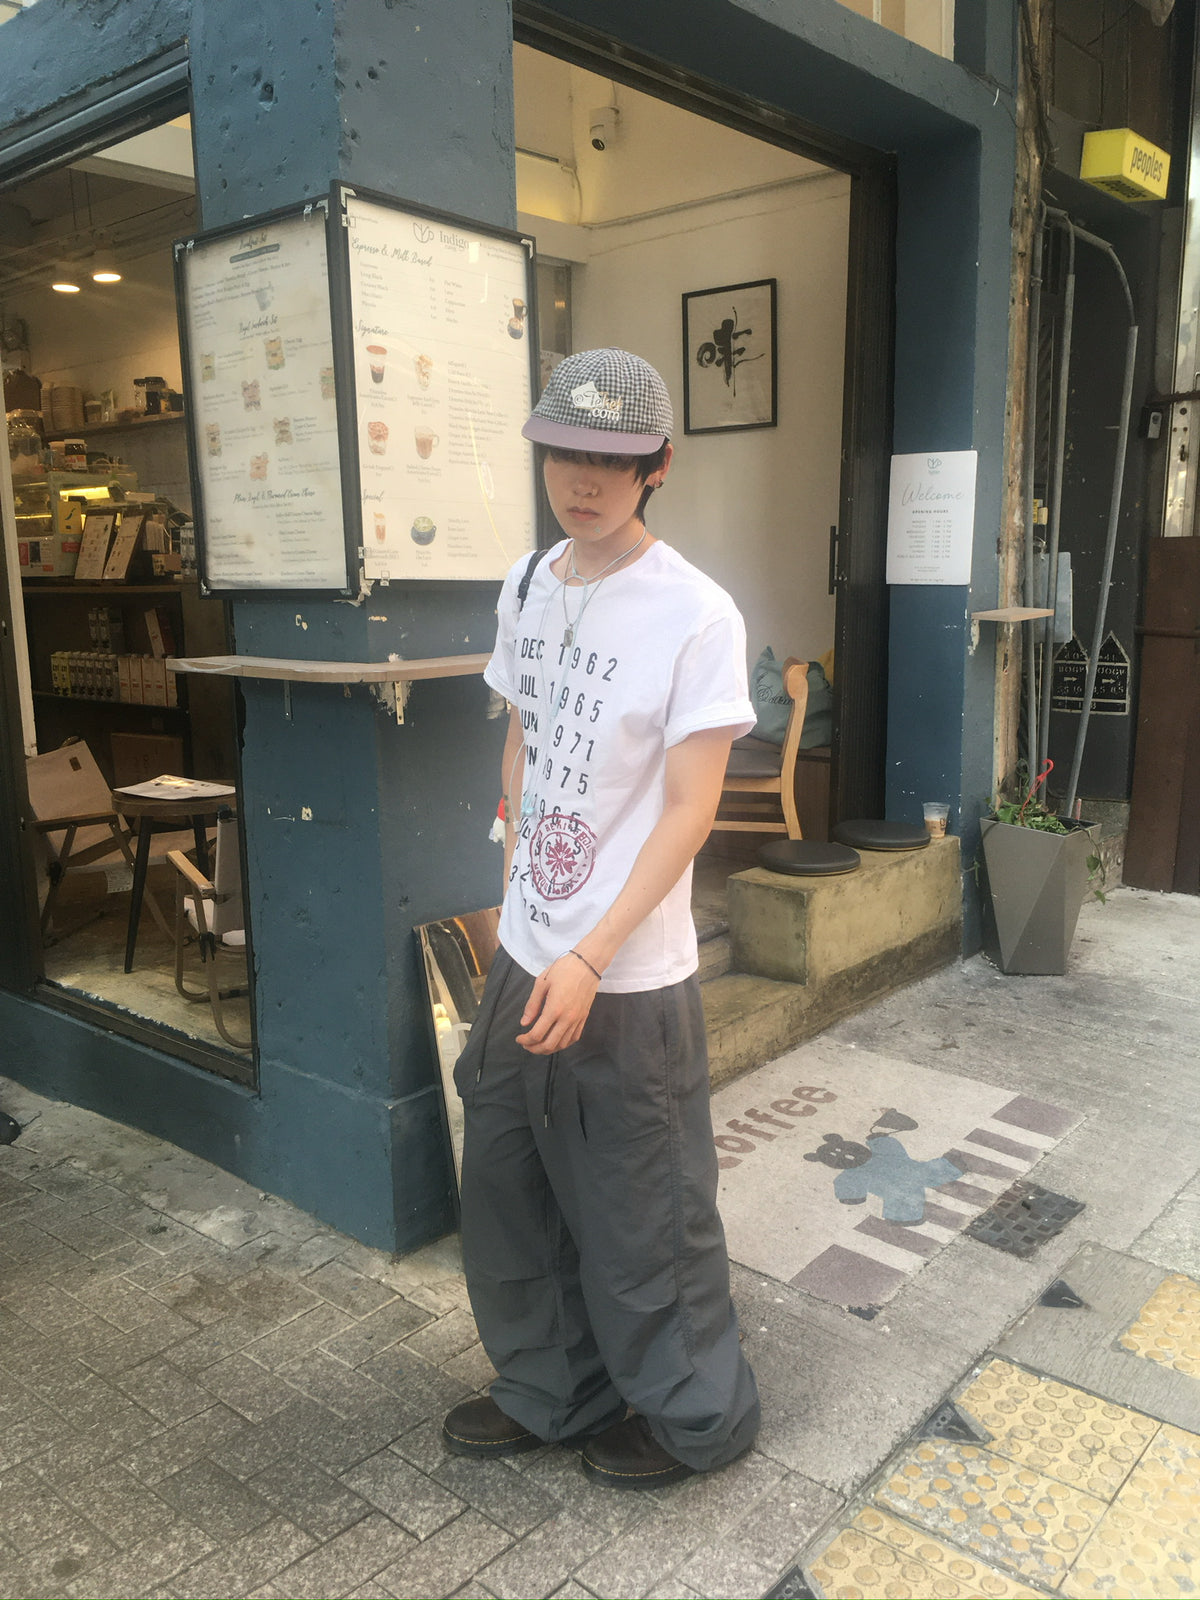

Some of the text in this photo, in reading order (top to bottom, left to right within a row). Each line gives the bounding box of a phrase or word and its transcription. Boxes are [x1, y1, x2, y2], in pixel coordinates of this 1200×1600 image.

[1129, 147, 1164, 183] peoples
[587, 407, 620, 421] .com
[901, 482, 965, 506] Welcome
[520, 637, 545, 661] DEC
[518, 674, 539, 699] JUL
